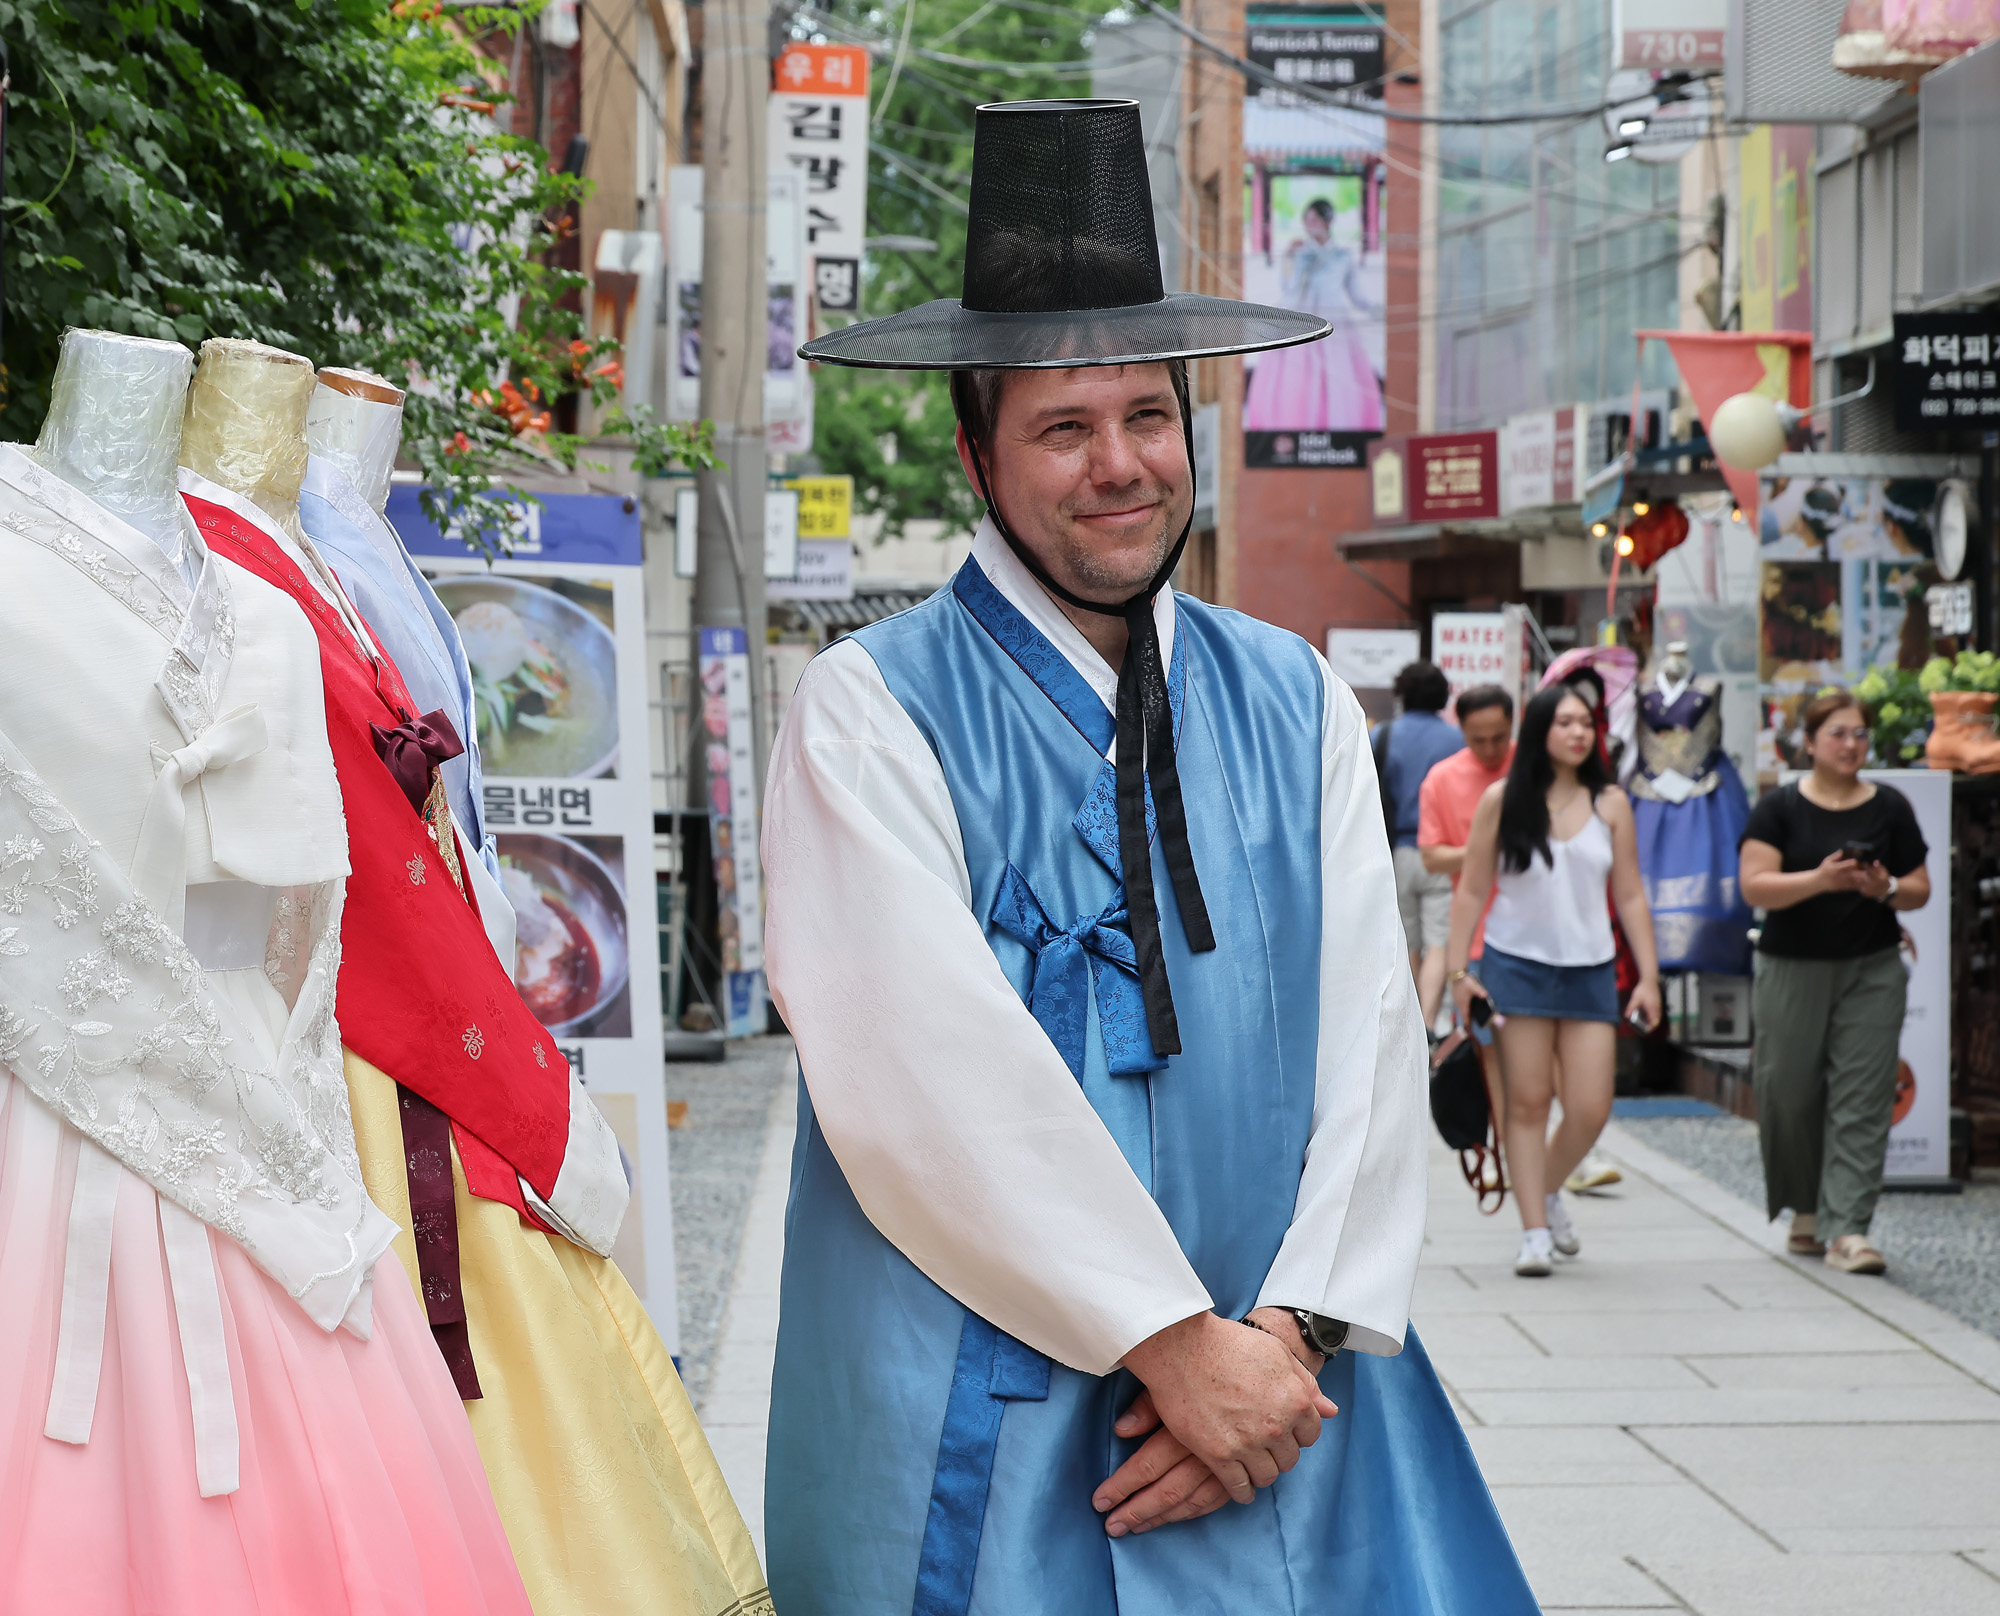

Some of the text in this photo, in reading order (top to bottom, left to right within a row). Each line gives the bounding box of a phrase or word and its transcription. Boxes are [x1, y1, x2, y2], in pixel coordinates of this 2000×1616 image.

[1638, 32, 1727, 63] 730-
[784, 52, 853, 88] 우리
[1298, 446, 1357, 464] Hanbok
[484, 786, 592, 825] 물냉면
